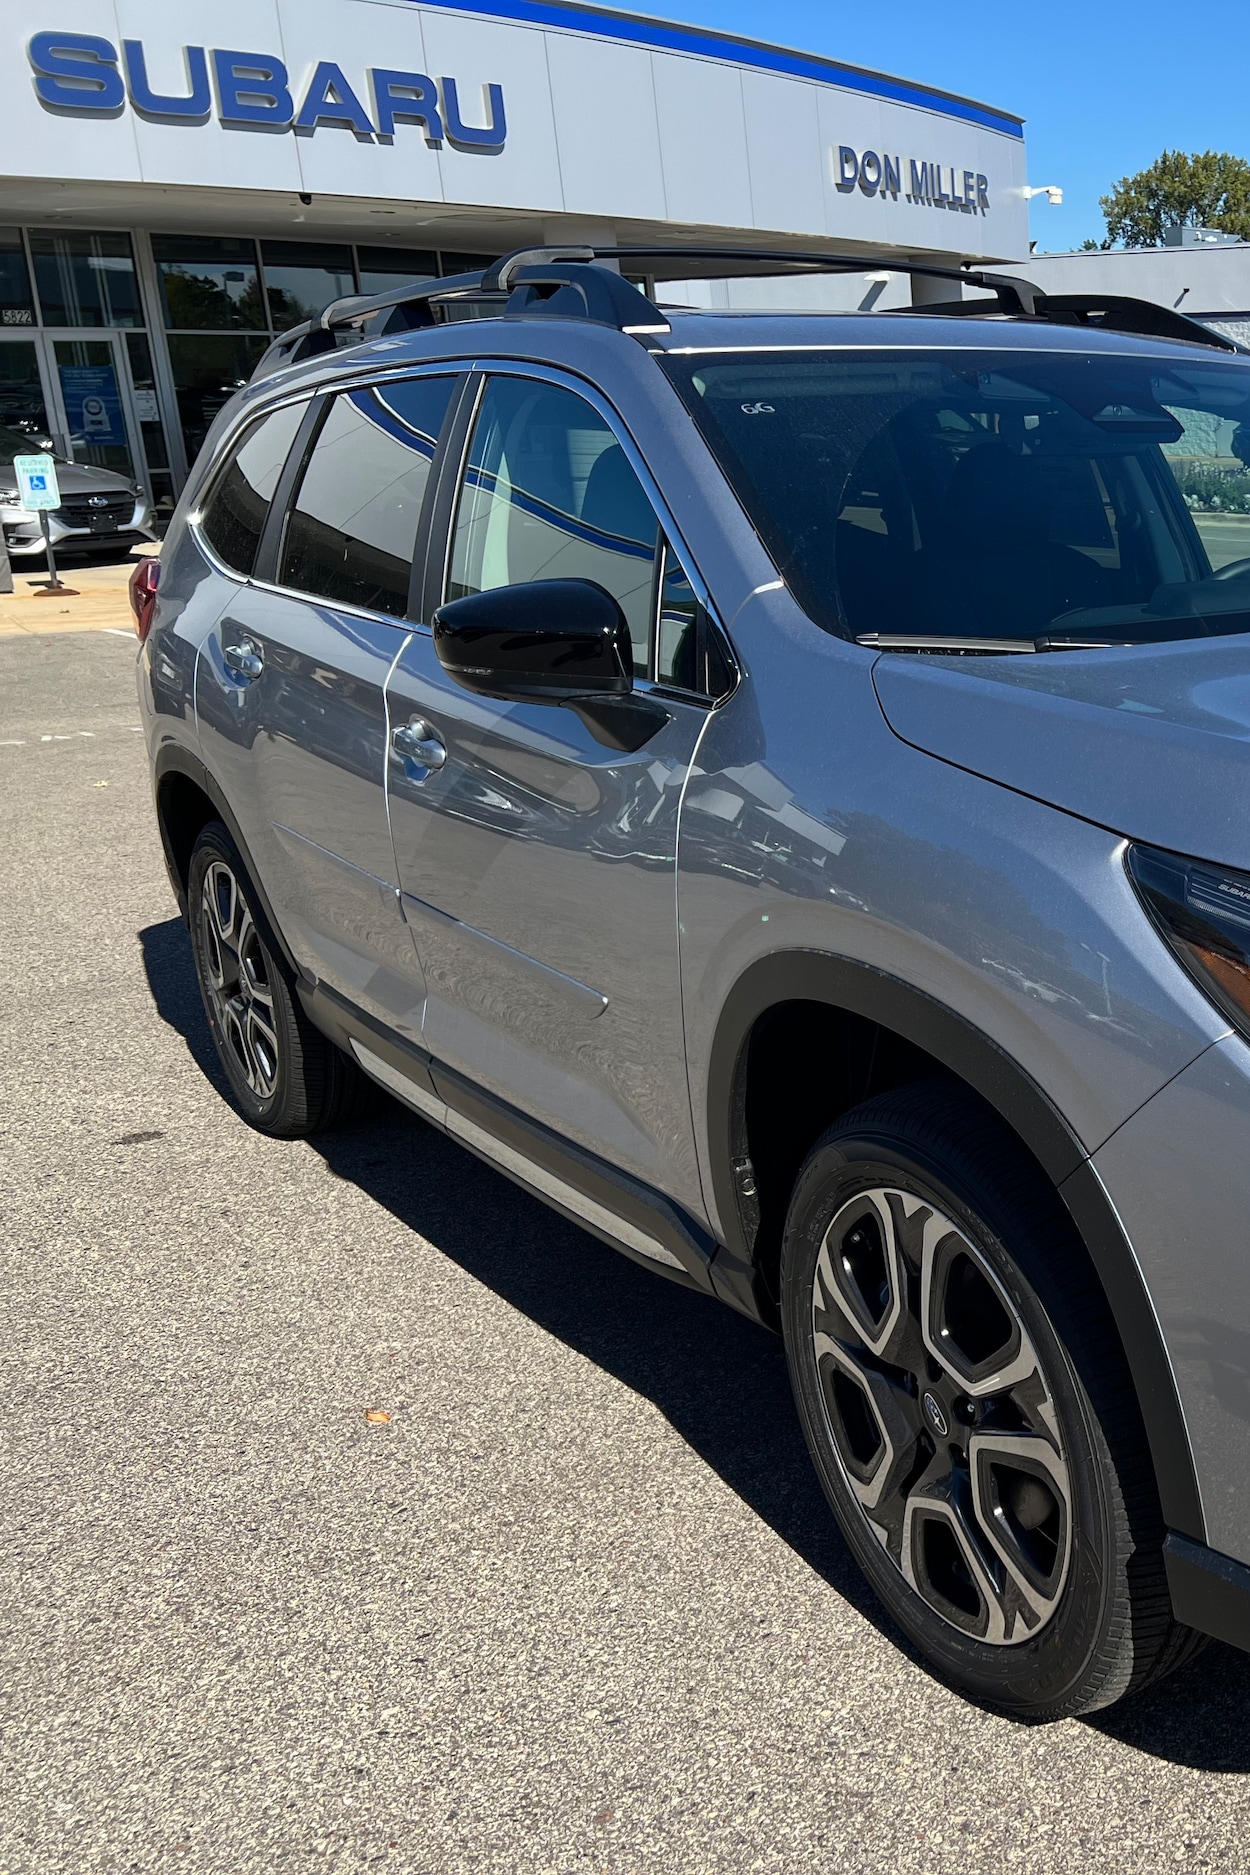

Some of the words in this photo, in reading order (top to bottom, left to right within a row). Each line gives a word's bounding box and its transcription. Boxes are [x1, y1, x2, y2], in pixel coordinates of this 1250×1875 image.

[28, 31, 508, 148] SUBARU
[834, 145, 902, 192] DON
[907, 158, 990, 209] MILLER
[3, 310, 32, 323] 5822
